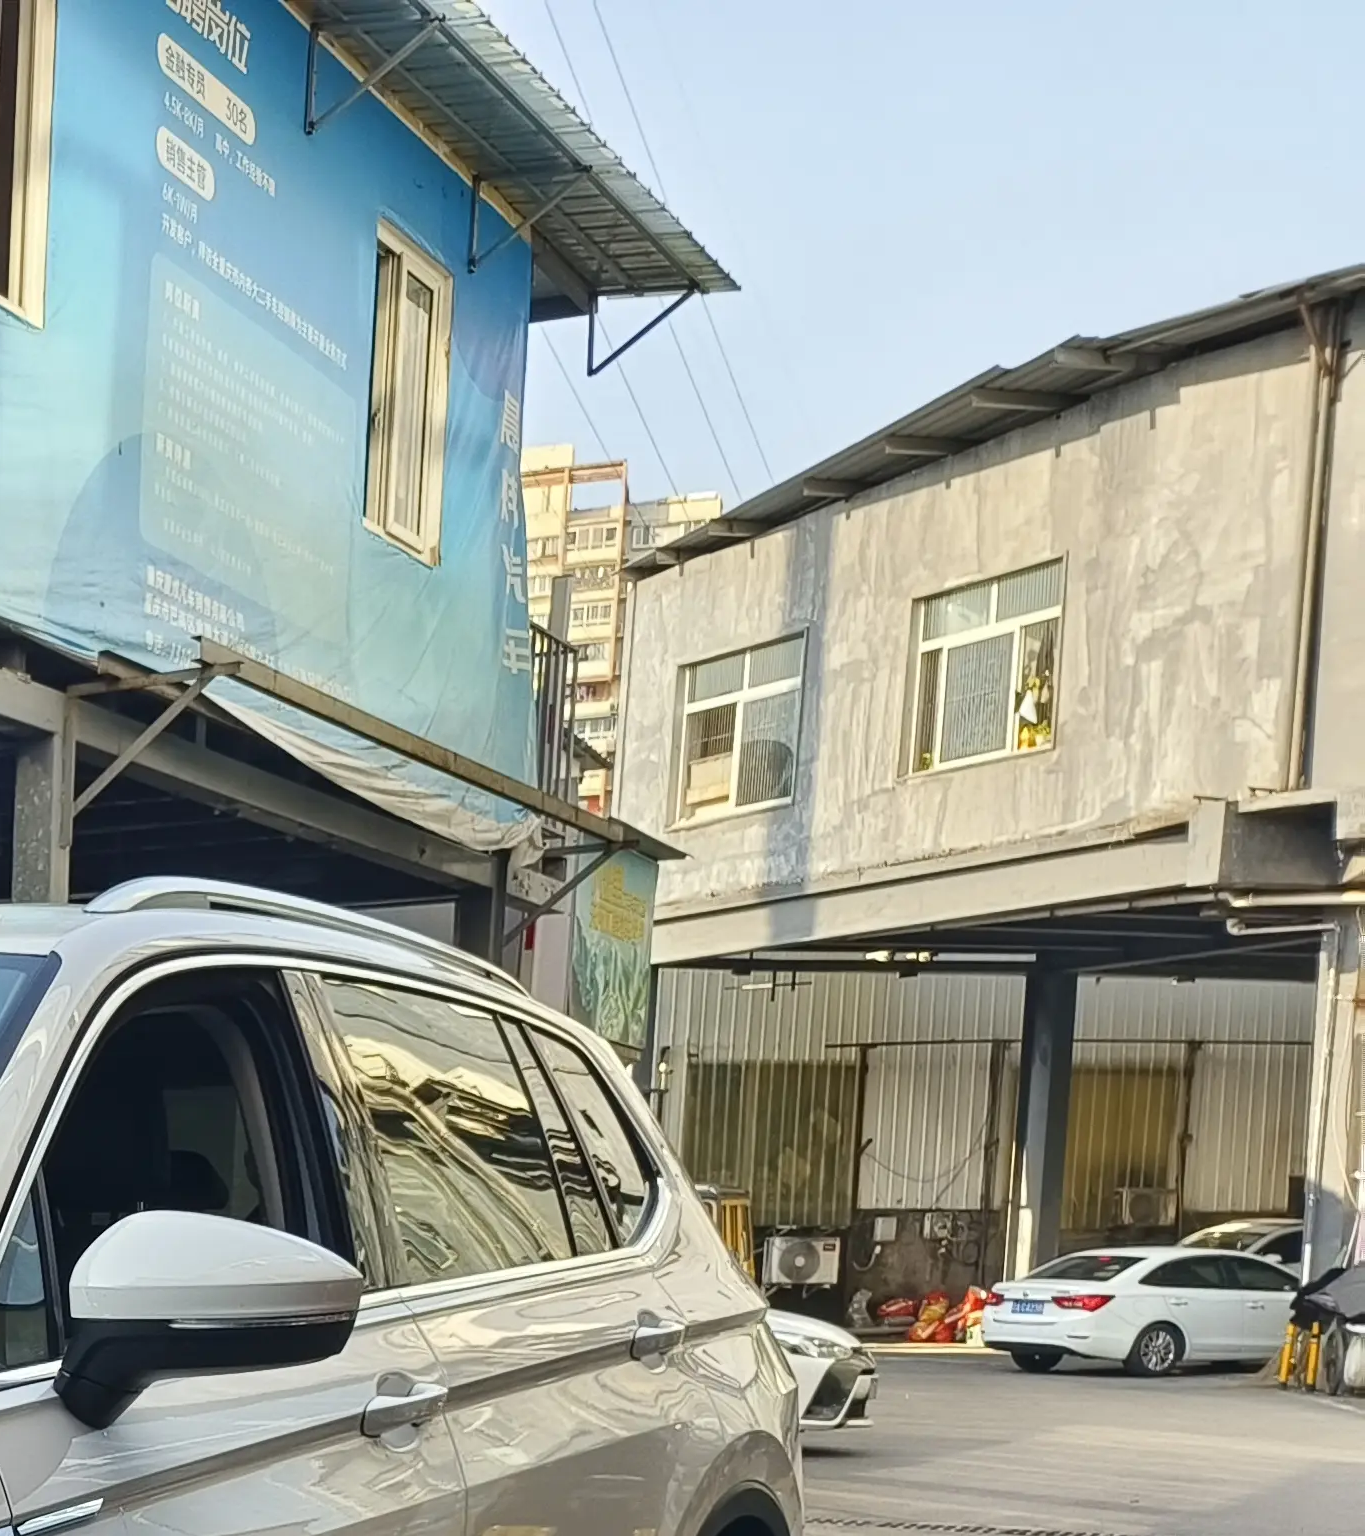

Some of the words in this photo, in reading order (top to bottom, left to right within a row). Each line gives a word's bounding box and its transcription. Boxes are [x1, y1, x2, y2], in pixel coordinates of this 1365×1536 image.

[166, 0, 250, 74] 聘岗位
[165, 45, 206, 101] 金融专员
[225, 97, 247, 135] 30名
[166, 137, 207, 192] 销售主管
